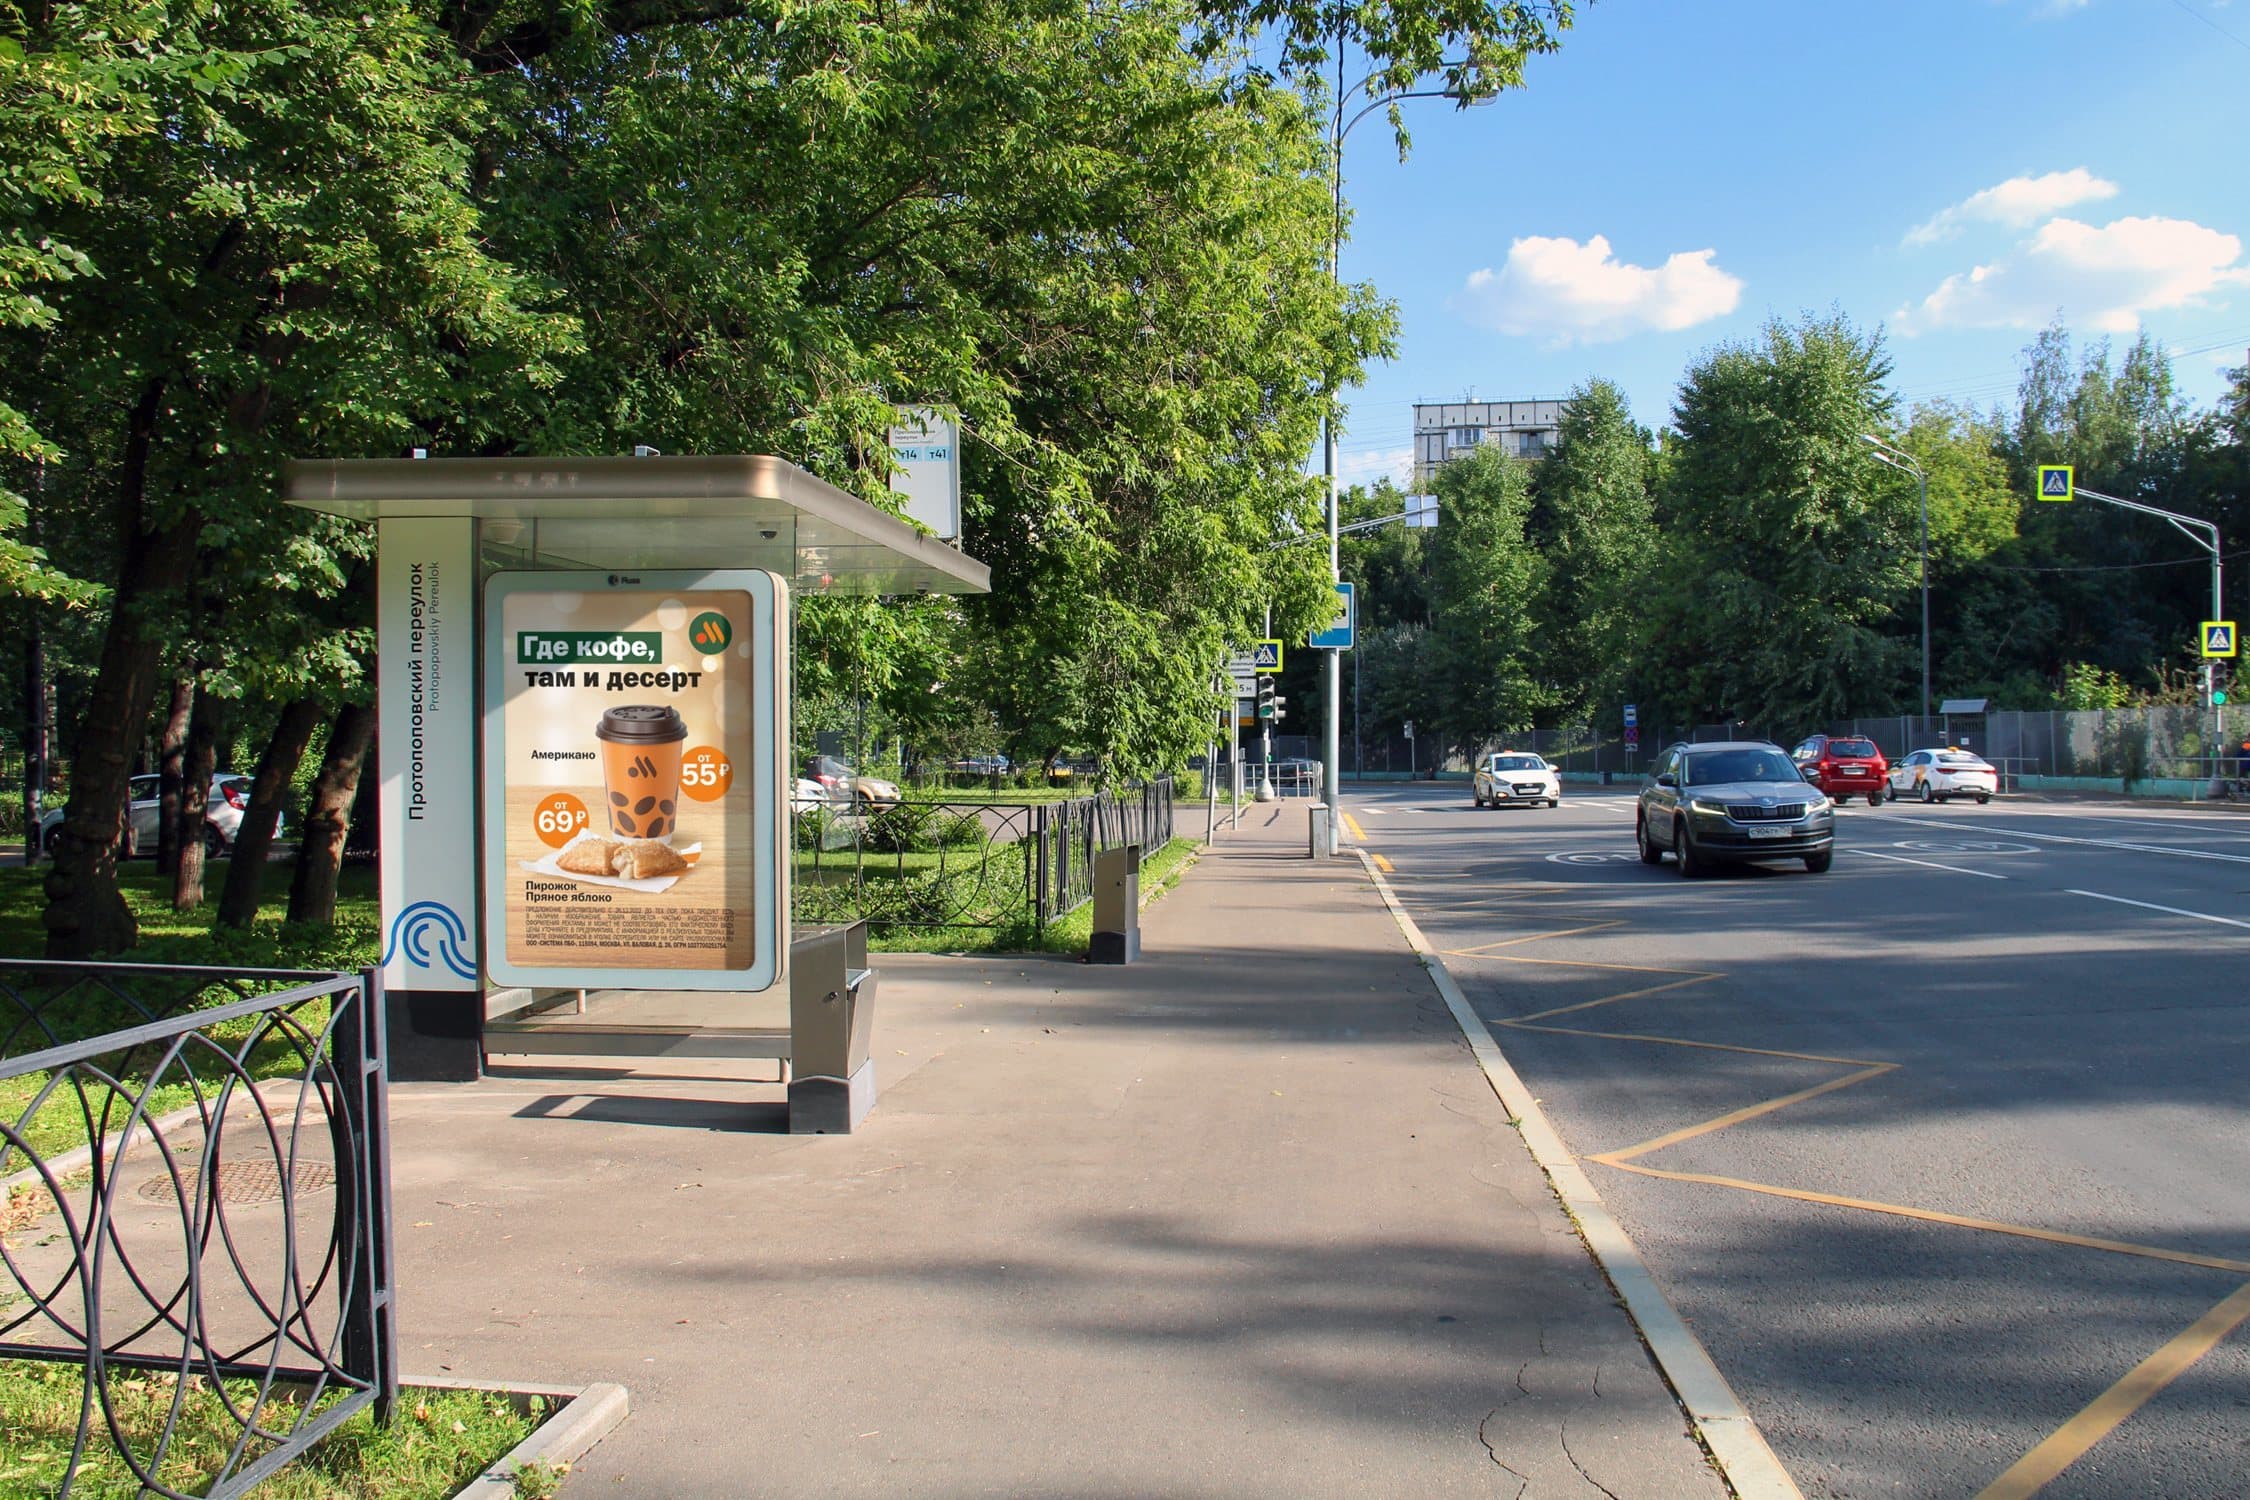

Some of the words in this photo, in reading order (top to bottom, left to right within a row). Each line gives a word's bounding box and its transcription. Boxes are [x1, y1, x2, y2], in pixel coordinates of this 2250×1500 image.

[900, 449, 917, 460] т14
[929, 448, 946, 459] т41
[428, 561, 440, 614] Pereulok
[411, 563, 426, 653] переулок
[523, 635, 569, 660] Где
[576, 635, 655, 661] кофе,
[429, 618, 441, 711] Protopopovskiy
[524, 671, 576, 688] там
[584, 671, 599, 687] и
[606, 671, 702, 692] десерт
[408, 660, 427, 820] Протопоповский
[531, 749, 596, 761] Американо
[697, 754, 711, 763] от
[554, 801, 568, 810] от
[526, 880, 577, 892] Пирожок
[526, 891, 568, 903] Пряное
[571, 892, 612, 902] яблоко
